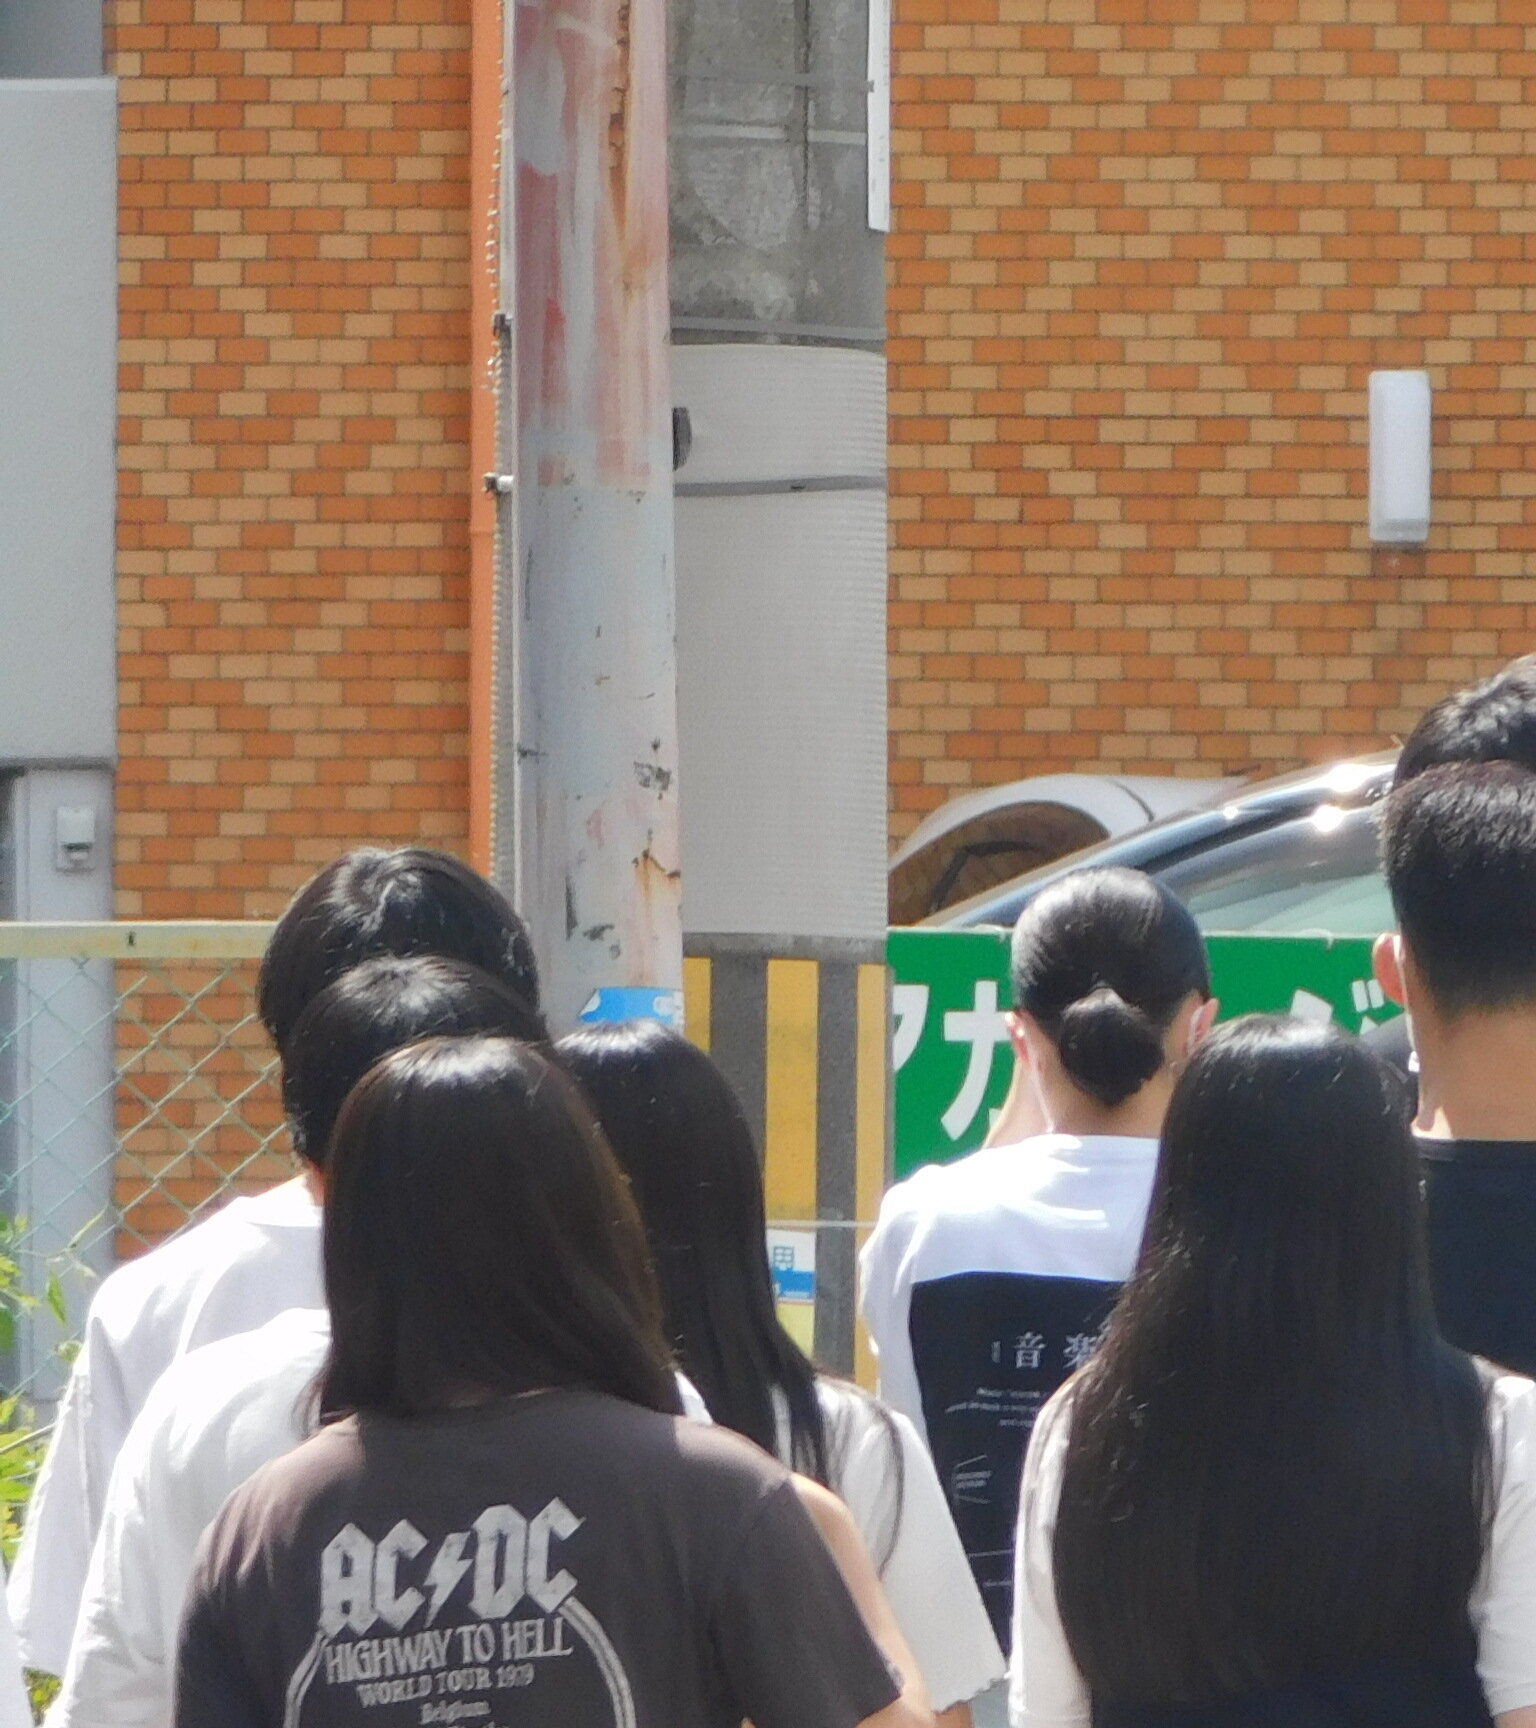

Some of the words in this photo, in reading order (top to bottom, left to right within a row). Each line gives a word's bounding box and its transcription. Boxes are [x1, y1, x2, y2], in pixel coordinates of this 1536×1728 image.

[325, 1627, 455, 1685] HIGHWAY
[456, 1622, 496, 1665] TO
[502, 1616, 575, 1662] HELL
[356, 1674, 433, 1709] WORLD
[434, 1666, 493, 1696] TOUR
